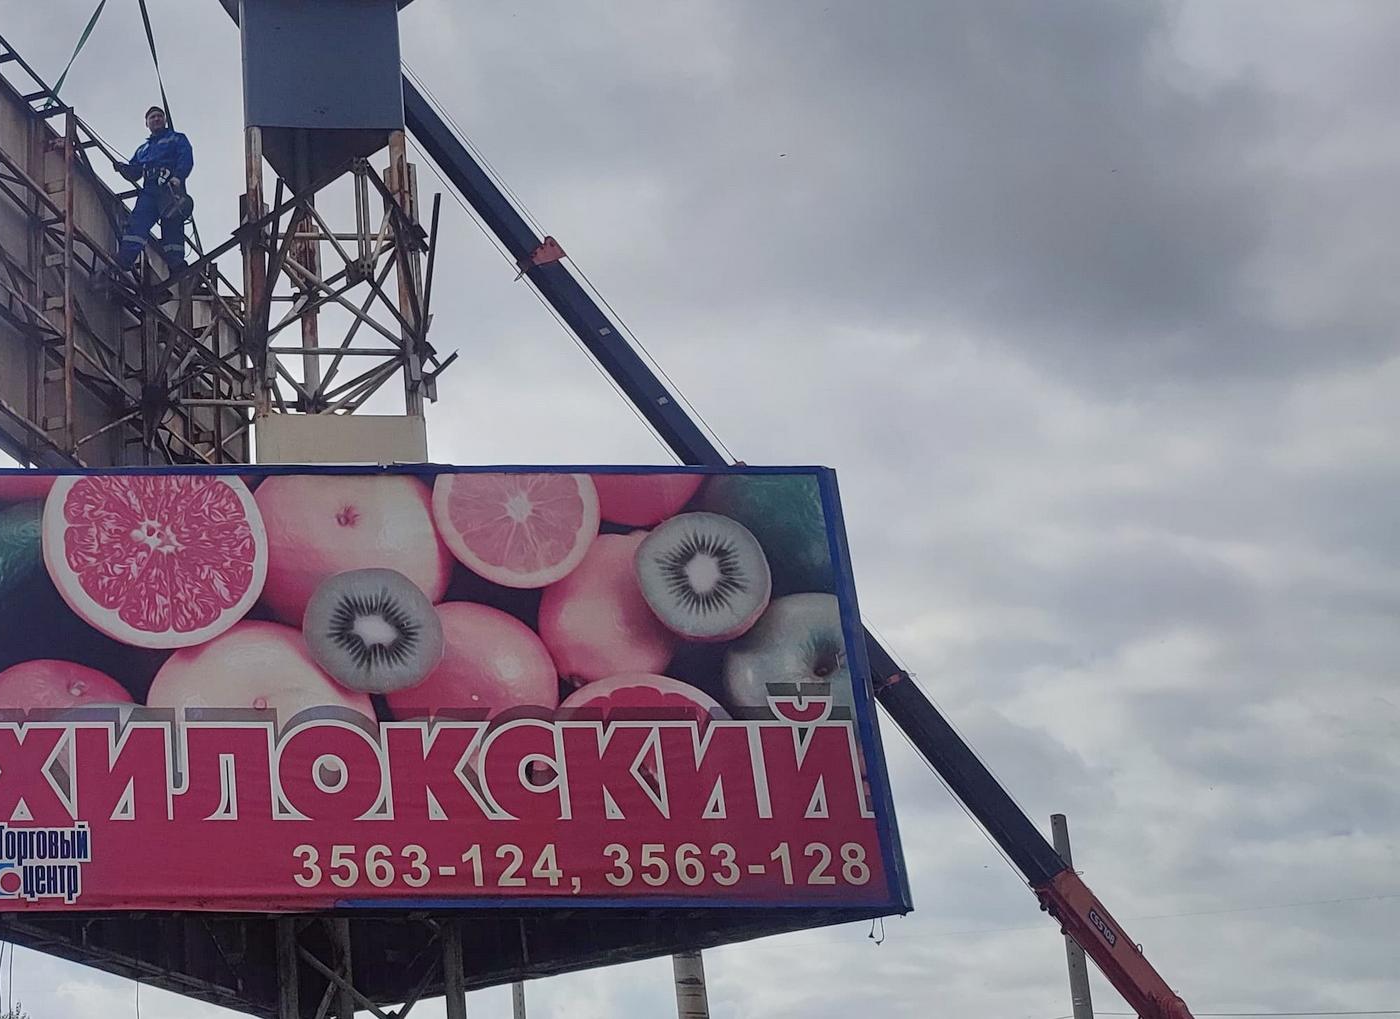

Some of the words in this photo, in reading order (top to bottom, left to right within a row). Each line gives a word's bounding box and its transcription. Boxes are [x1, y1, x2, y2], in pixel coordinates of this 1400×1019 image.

[23, 865, 78, 901] центр
[292, 843, 582, 894] 3563-124,
[603, 842, 872, 887] 3563-128
